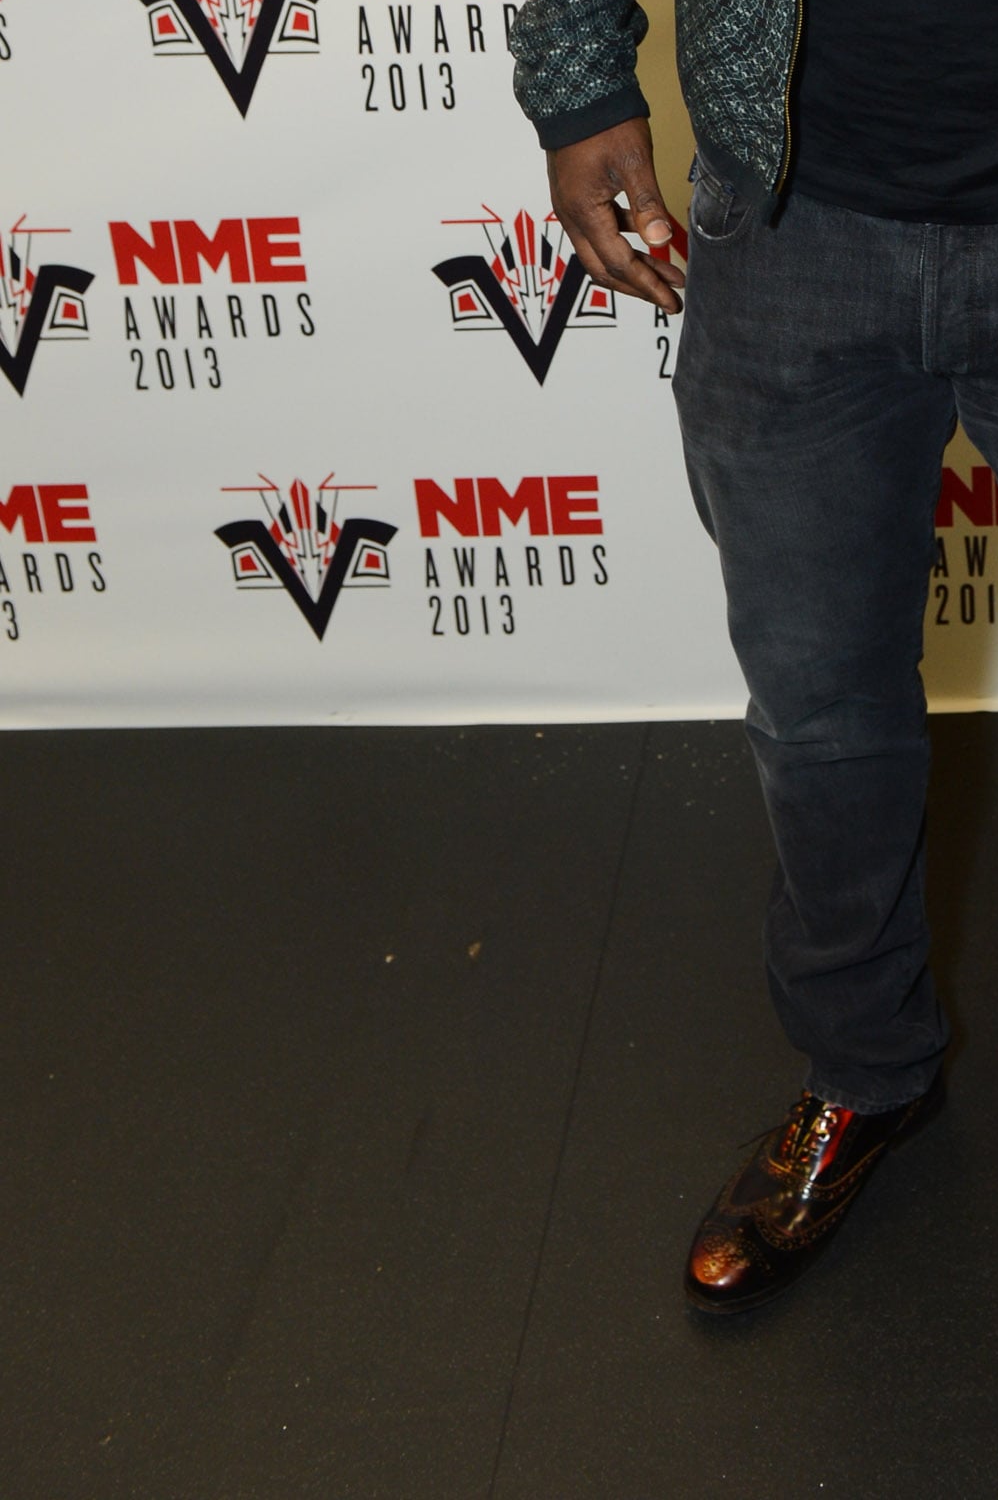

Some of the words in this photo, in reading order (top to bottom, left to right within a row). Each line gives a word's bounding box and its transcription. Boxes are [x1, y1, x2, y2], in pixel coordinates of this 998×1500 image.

[358, 4, 518, 54] AWARD
[361, 63, 456, 112] 2013
[108, 217, 307, 285] NME
[124, 293, 315, 341] AWARDS
[130, 348, 222, 391] 2013
[0, 484, 97, 543] ME
[414, 475, 603, 537] NME
[425, 544, 609, 588] AWARDS
[429, 594, 515, 636] 2013
